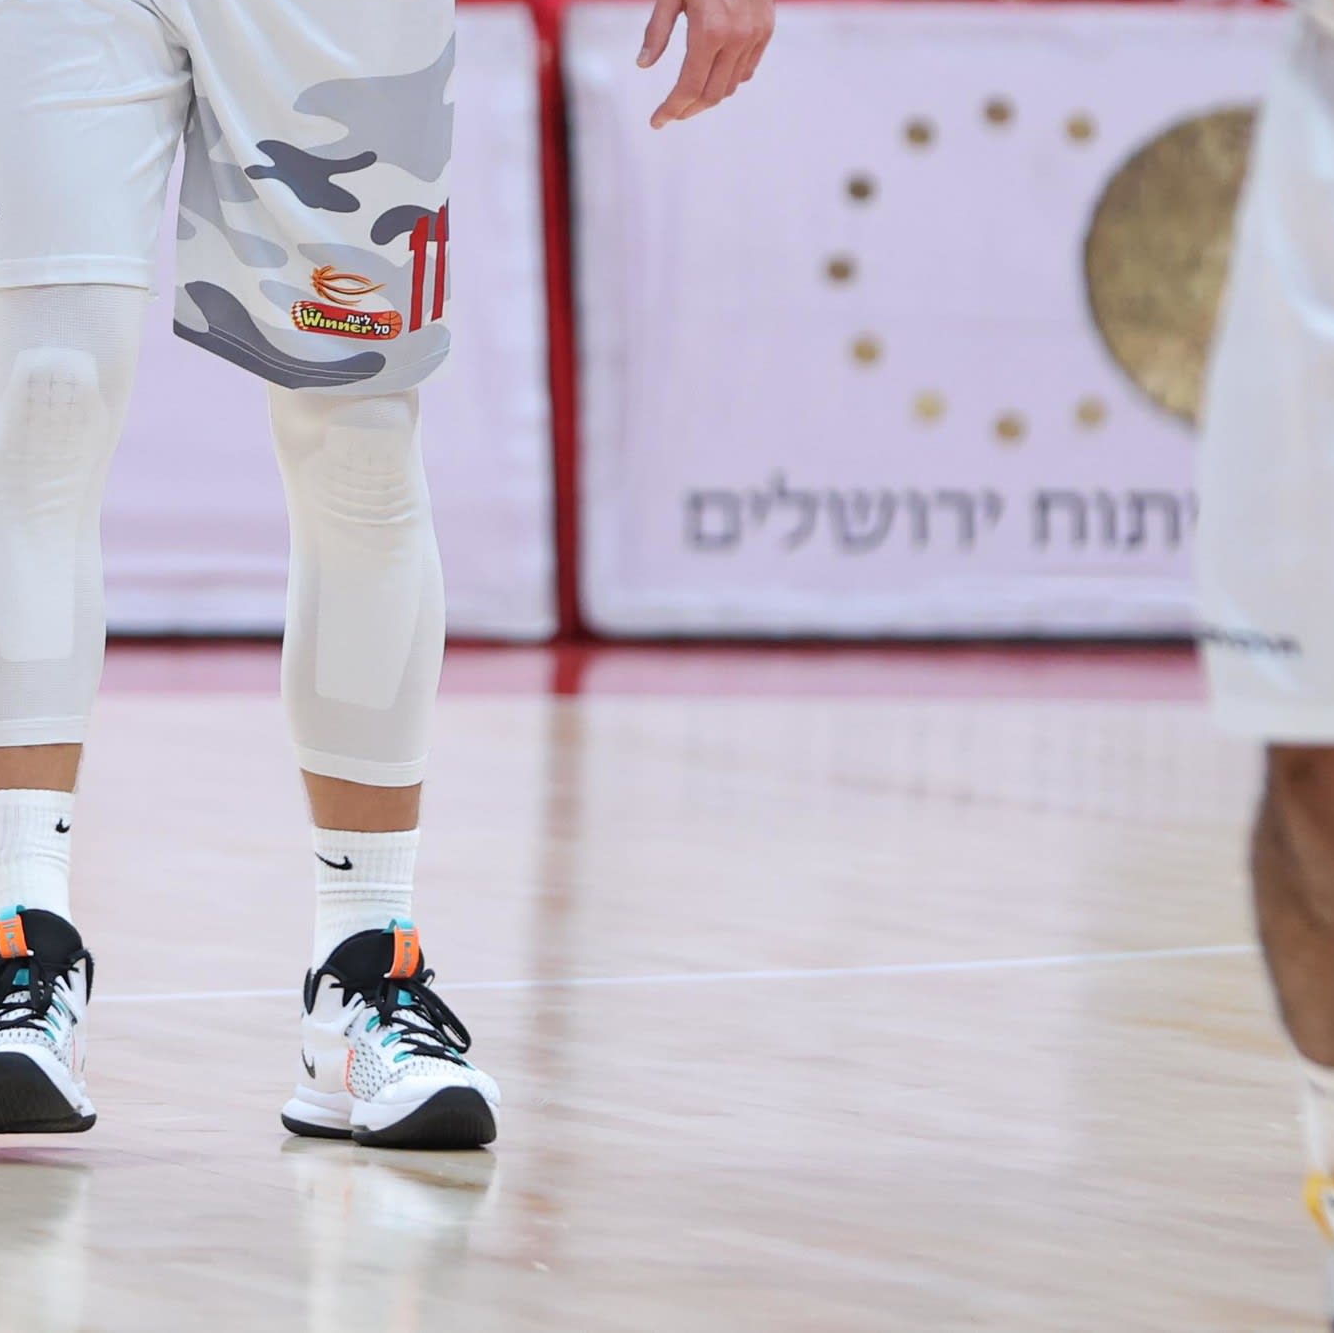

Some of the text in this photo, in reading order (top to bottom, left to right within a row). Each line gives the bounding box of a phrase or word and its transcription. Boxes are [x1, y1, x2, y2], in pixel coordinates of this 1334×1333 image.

[409, 204, 447, 333] 11
[346, 313, 372, 325] ליגת
[374, 322, 391, 335] סל
[683, 469, 1200, 554] יתוח ירושלים
